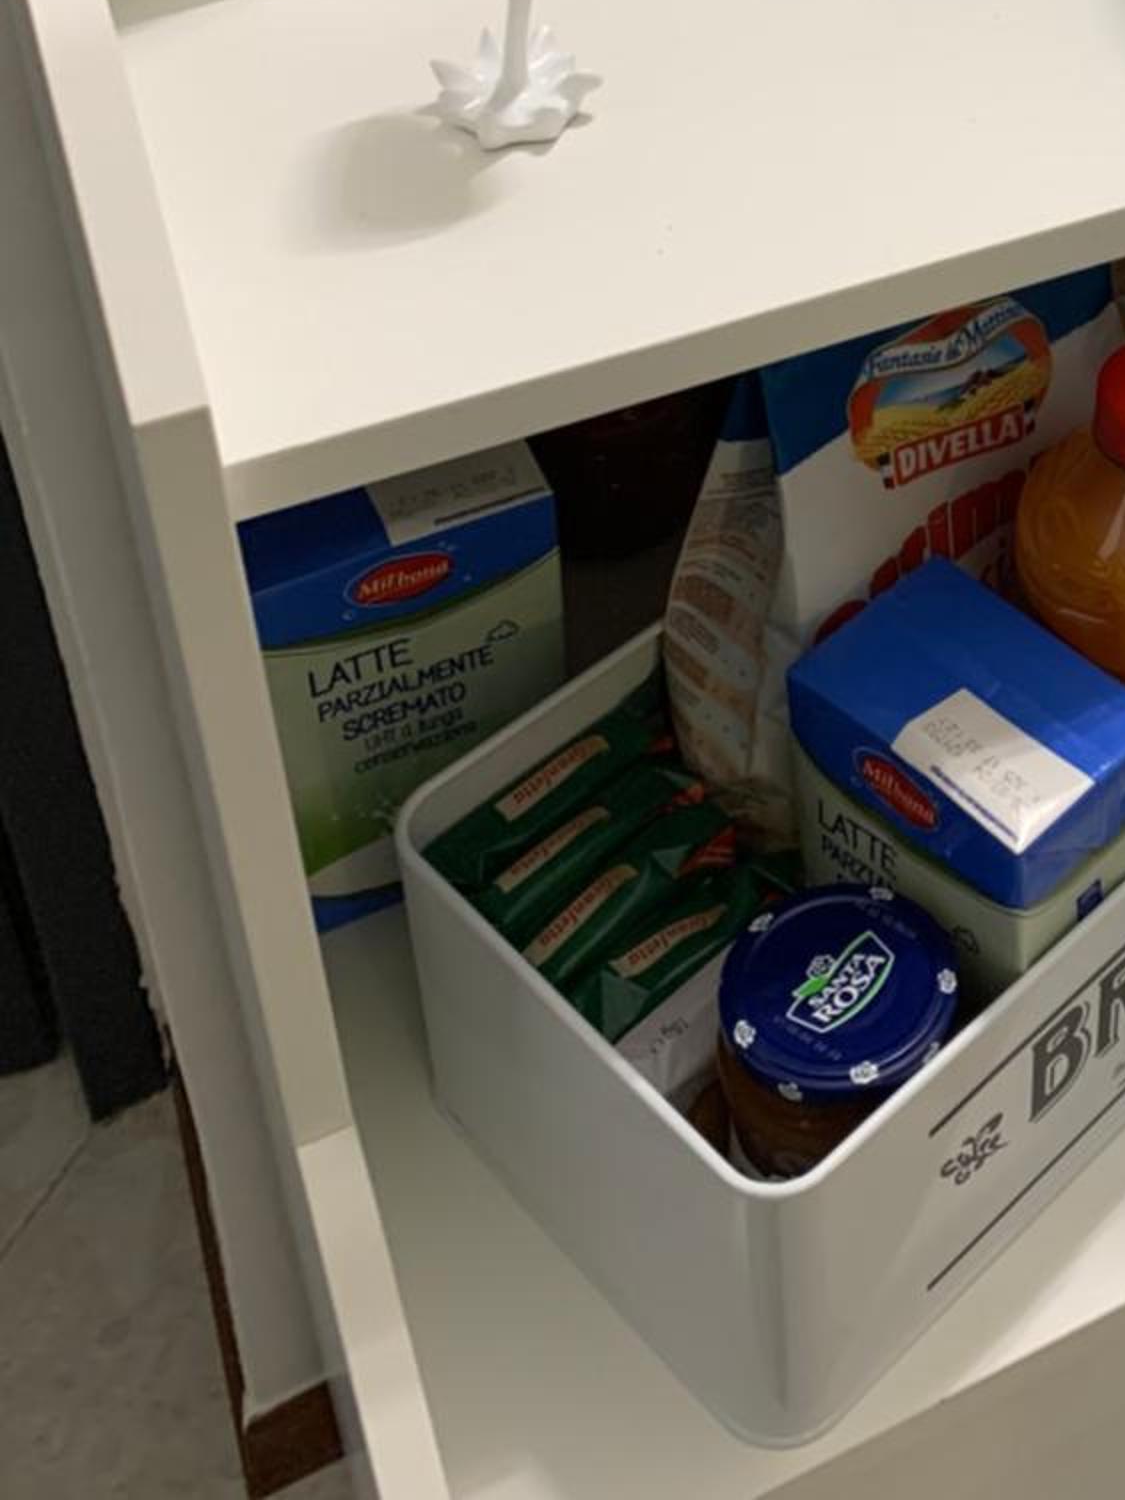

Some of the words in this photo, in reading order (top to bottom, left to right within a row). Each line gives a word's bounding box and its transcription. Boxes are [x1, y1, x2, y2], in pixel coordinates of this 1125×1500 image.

[900, 412, 1021, 477] DIVELLA
[307, 637, 413, 698] LATTE
[318, 644, 495, 722] PARZIALMENTE
[342, 681, 466, 741] SCREMATO
[818, 798, 897, 870] LATTE
[808, 953, 866, 1009] SANTA
[810, 953, 886, 1023] ROSA
